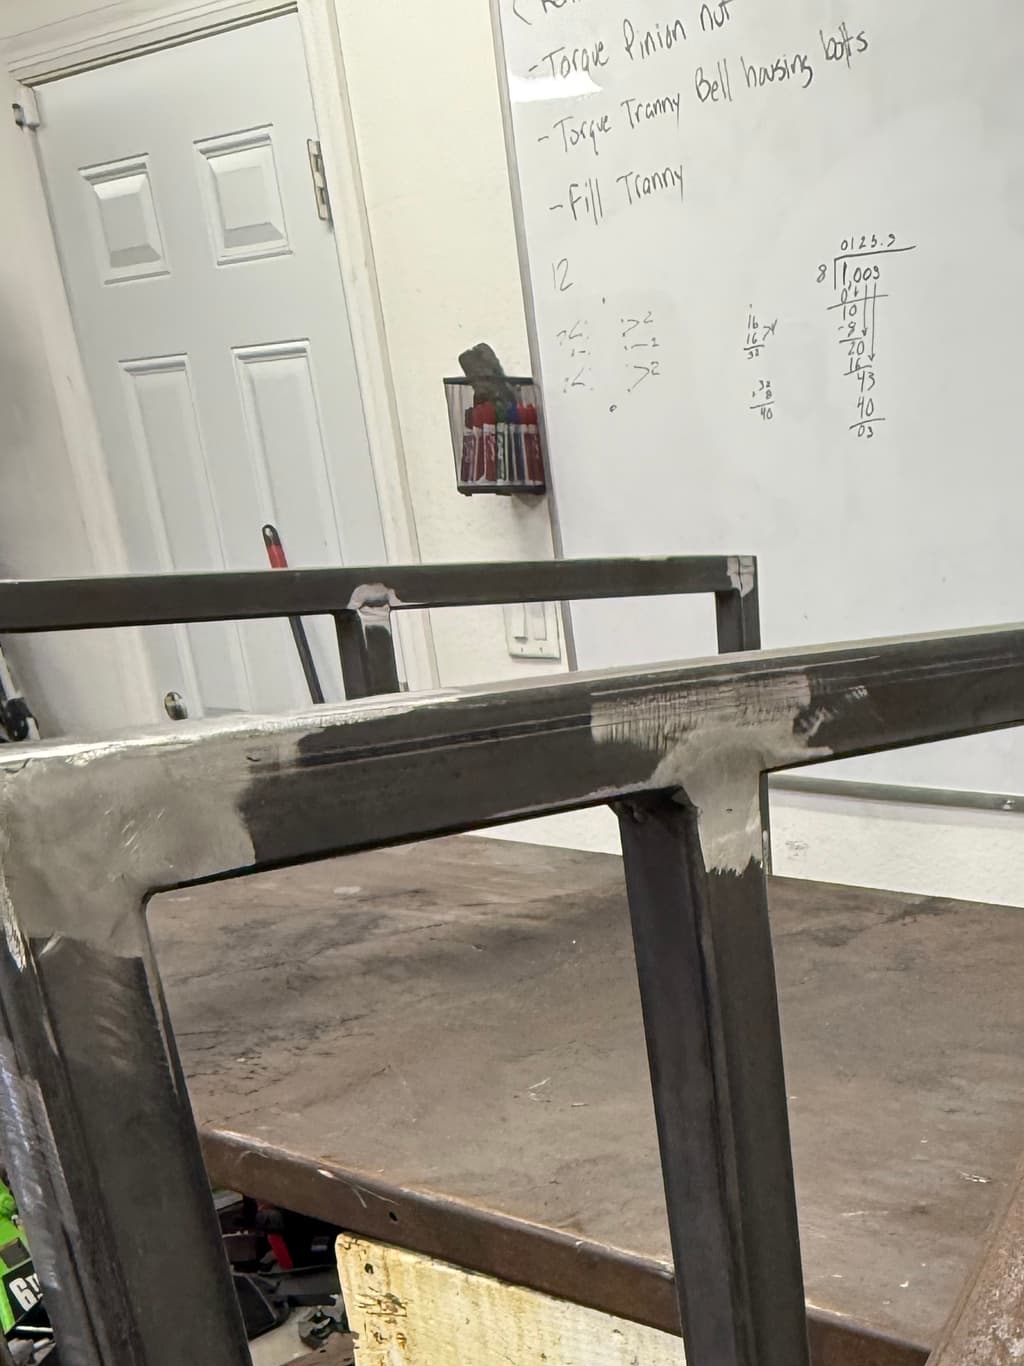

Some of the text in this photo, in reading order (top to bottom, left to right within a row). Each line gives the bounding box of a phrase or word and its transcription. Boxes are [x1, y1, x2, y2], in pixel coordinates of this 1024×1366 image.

[622, 18, 687, 61] Pinion
[620, 92, 681, 129] Tranny
[695, 57, 733, 102] Bell
[616, 164, 684, 205] Tranny
[551, 257, 574, 292] 12
